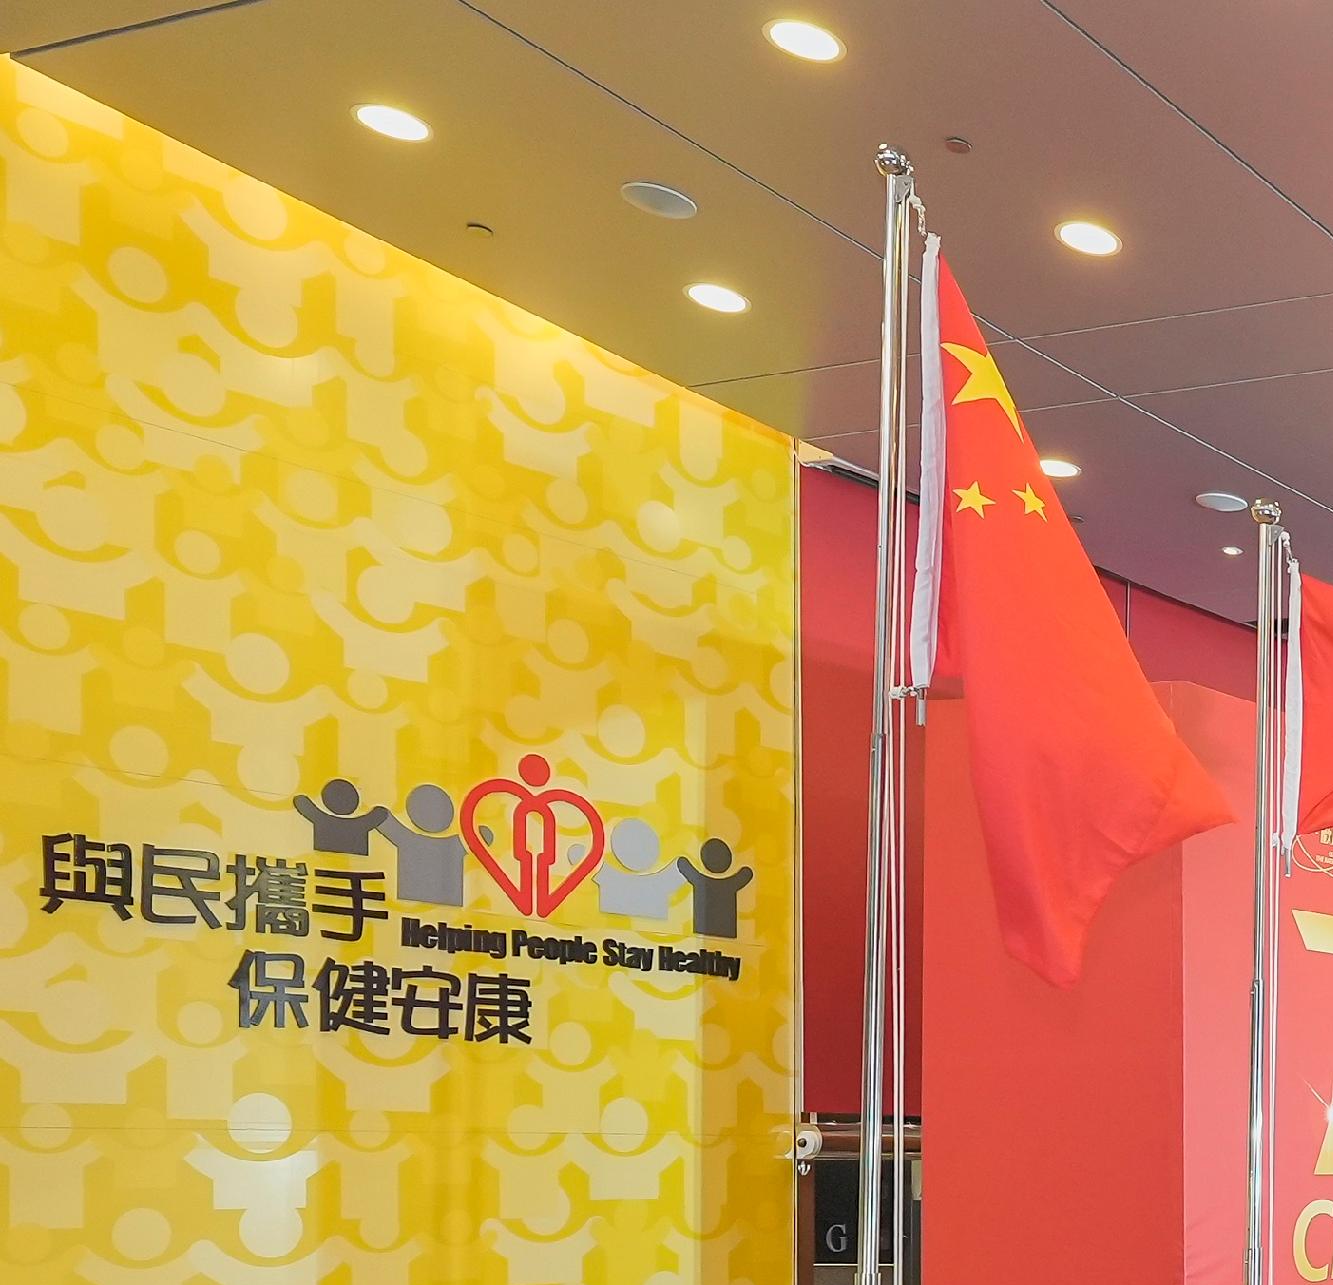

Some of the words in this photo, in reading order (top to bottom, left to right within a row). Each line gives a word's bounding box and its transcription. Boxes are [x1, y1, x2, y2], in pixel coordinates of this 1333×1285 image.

[40, 831, 389, 942] 與民攜手
[401, 916, 507, 959] Helping
[511, 928, 599, 968] People
[602, 940, 653, 972] Stay
[658, 945, 742, 981] Healthy
[227, 950, 533, 1046] 保健安康
[825, 1223, 848, 1253] G
